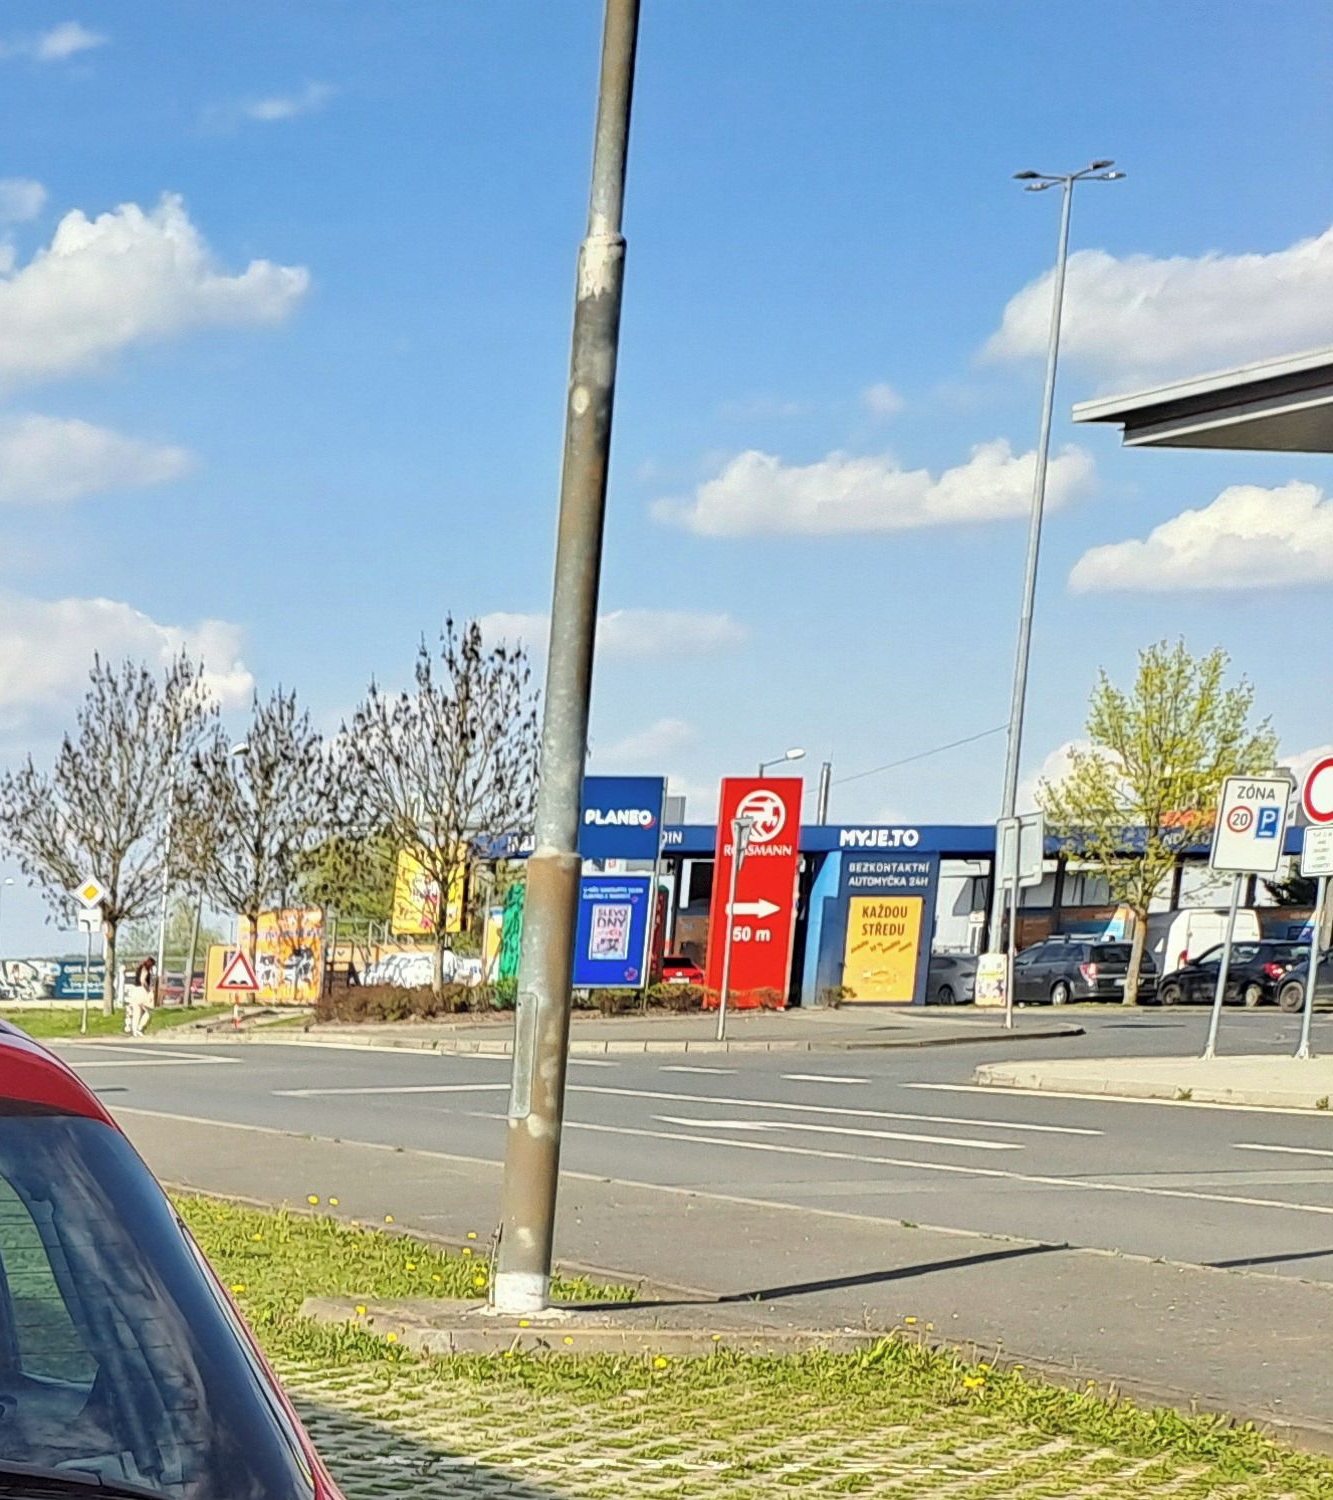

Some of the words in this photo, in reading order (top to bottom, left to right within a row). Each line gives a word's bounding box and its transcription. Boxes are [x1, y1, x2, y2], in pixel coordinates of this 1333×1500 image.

[1237, 784, 1276, 800] ZÓNA
[584, 808, 652, 826] PLANEO
[1232, 813, 1249, 826] 20
[1261, 810, 1276, 830] P
[839, 829, 919, 847] MYJE.TO
[724, 844, 793, 857] RSMANN
[848, 861, 930, 874] BEZKONTAKTNÍ
[848, 875, 907, 887] AUTOMYČKA
[862, 903, 908, 919] KAŽDOU
[733, 926, 752, 943] 50
[755, 928, 771, 942] m
[861, 921, 906, 937] STŘEDU
